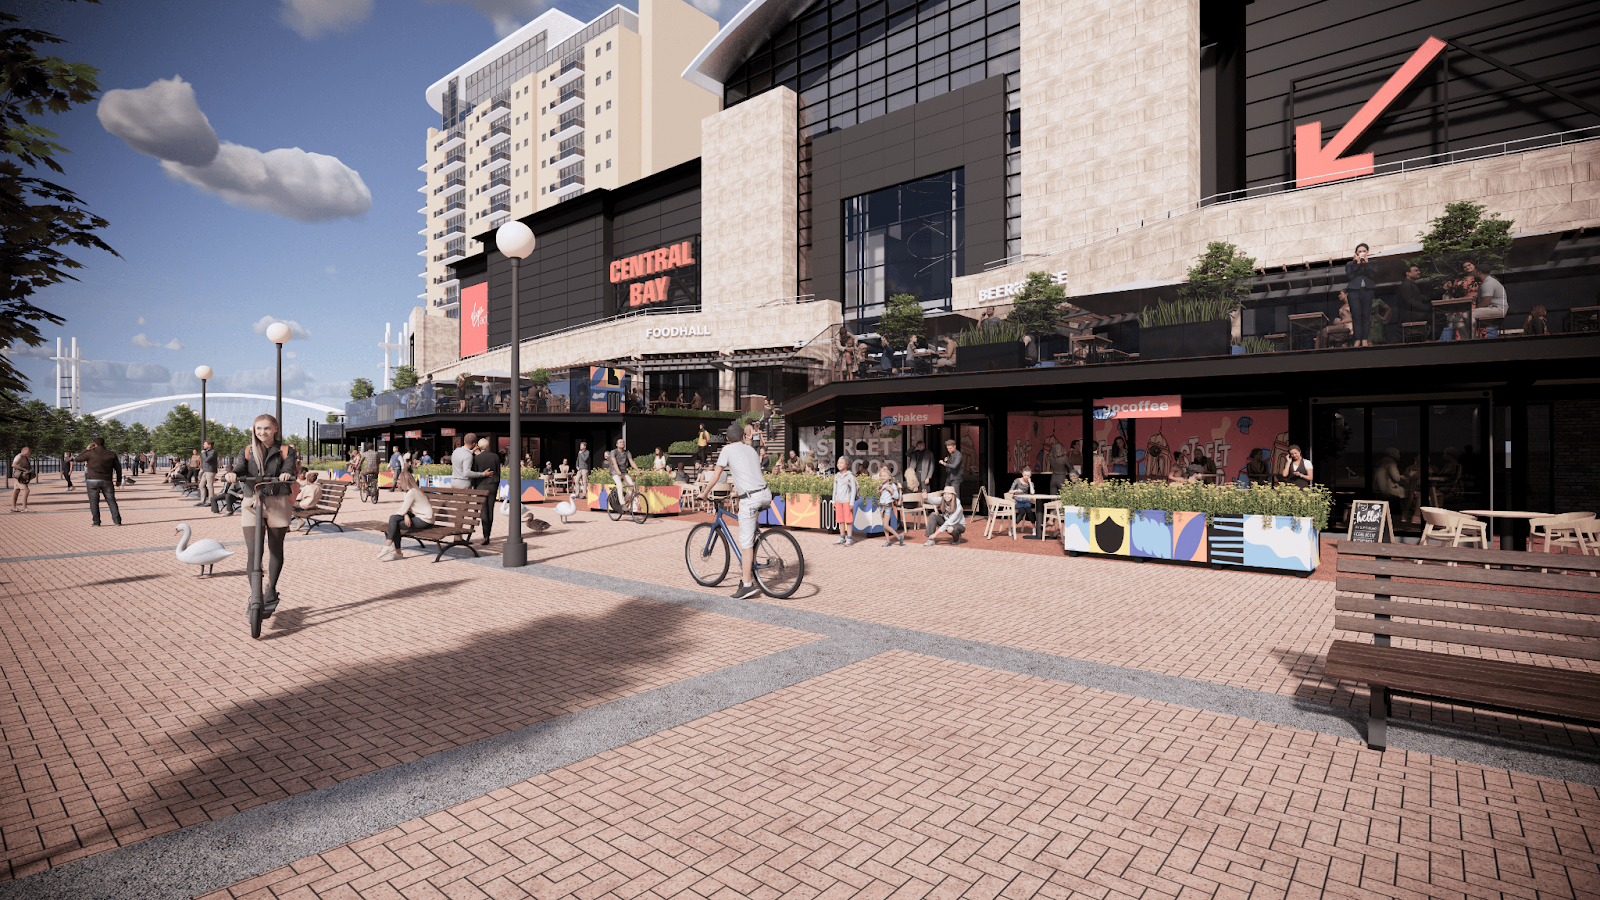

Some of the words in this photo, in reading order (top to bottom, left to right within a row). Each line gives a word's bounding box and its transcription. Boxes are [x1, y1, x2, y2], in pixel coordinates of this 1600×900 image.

[609, 240, 696, 284] CENTRAL
[629, 275, 671, 307] BAY
[646, 325, 711, 339] FOODHALL
[892, 412, 928, 423] shakes
